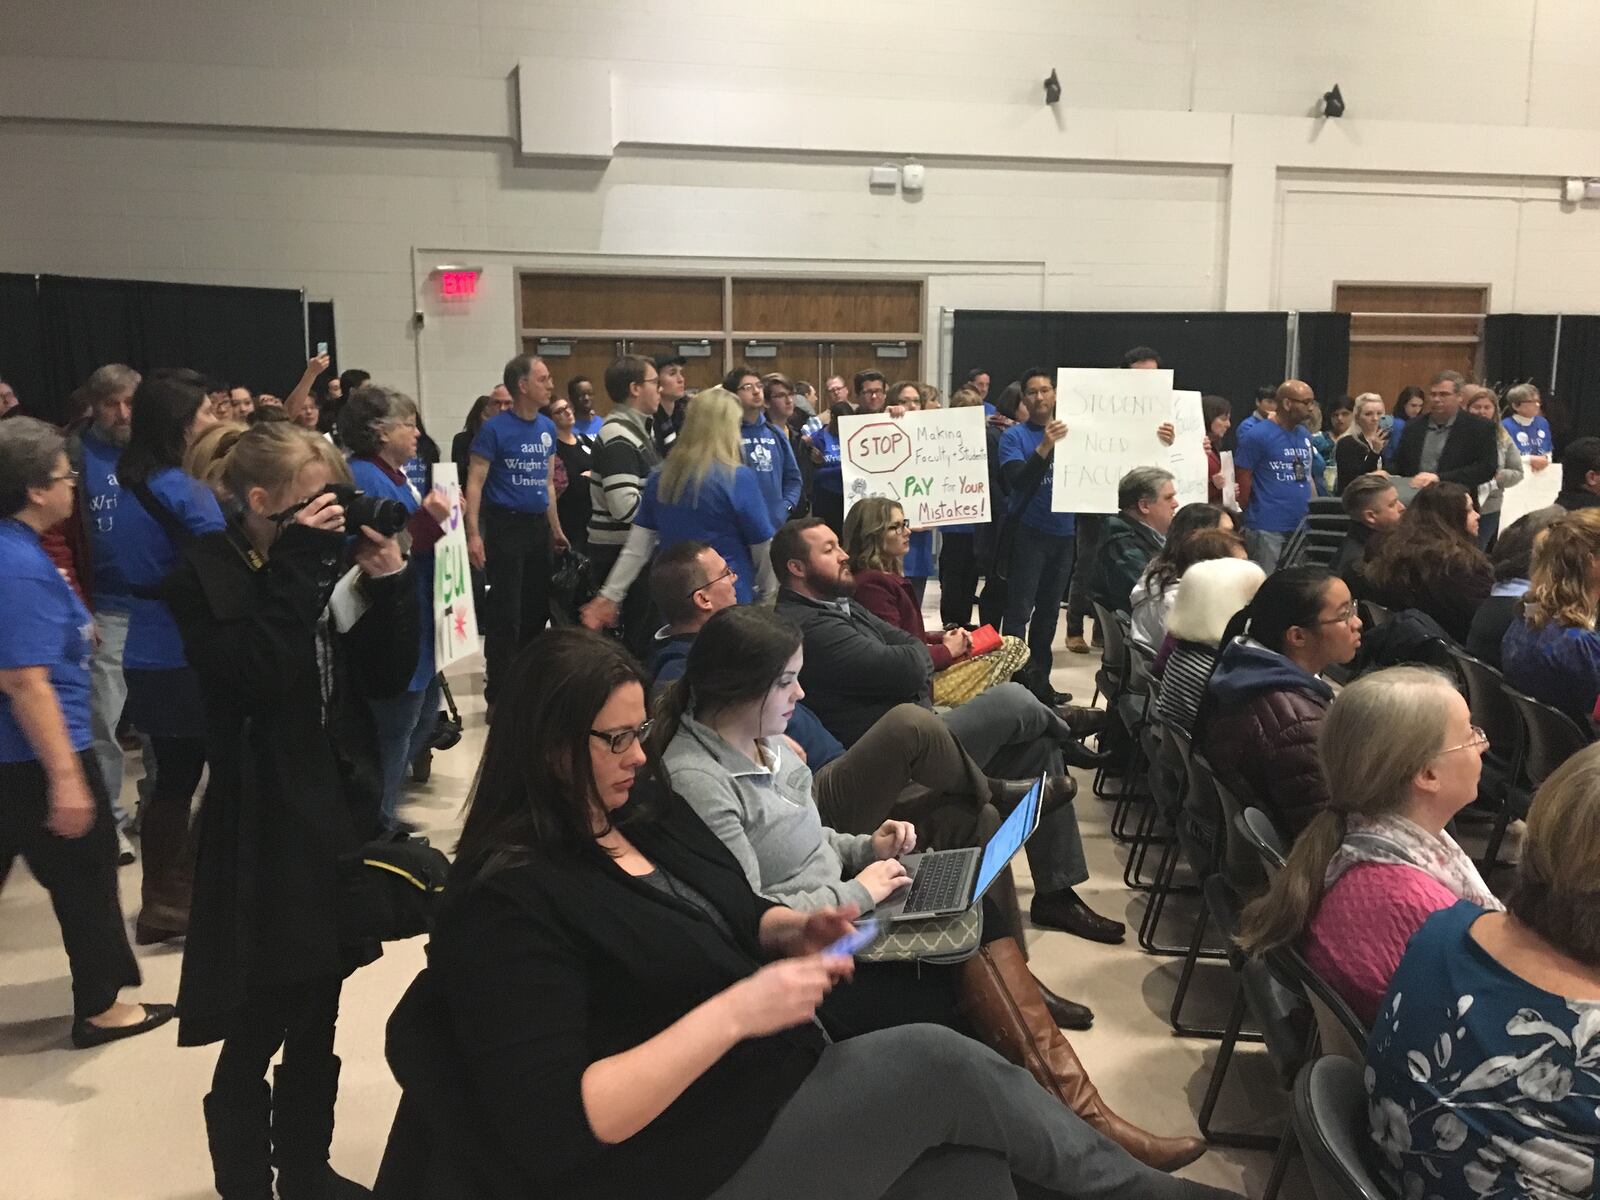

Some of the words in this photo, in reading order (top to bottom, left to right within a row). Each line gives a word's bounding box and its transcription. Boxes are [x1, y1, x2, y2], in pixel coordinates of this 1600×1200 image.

[443, 272, 477, 295] EXIT
[1069, 384, 1172, 416] STUDENTS
[520, 444, 549, 457] aaup
[860, 433, 903, 457] STOP
[917, 426, 963, 447] Making
[1084, 432, 1129, 453] NEED
[915, 445, 951, 468] Faculty
[1284, 448, 1309, 459] aaup
[504, 458, 541, 472] Wright
[904, 475, 934, 497] PAY
[942, 476, 957, 493] for
[959, 475, 985, 494] YOUR
[89, 493, 118, 512] Wri
[919, 498, 985, 521] Mistakes!
